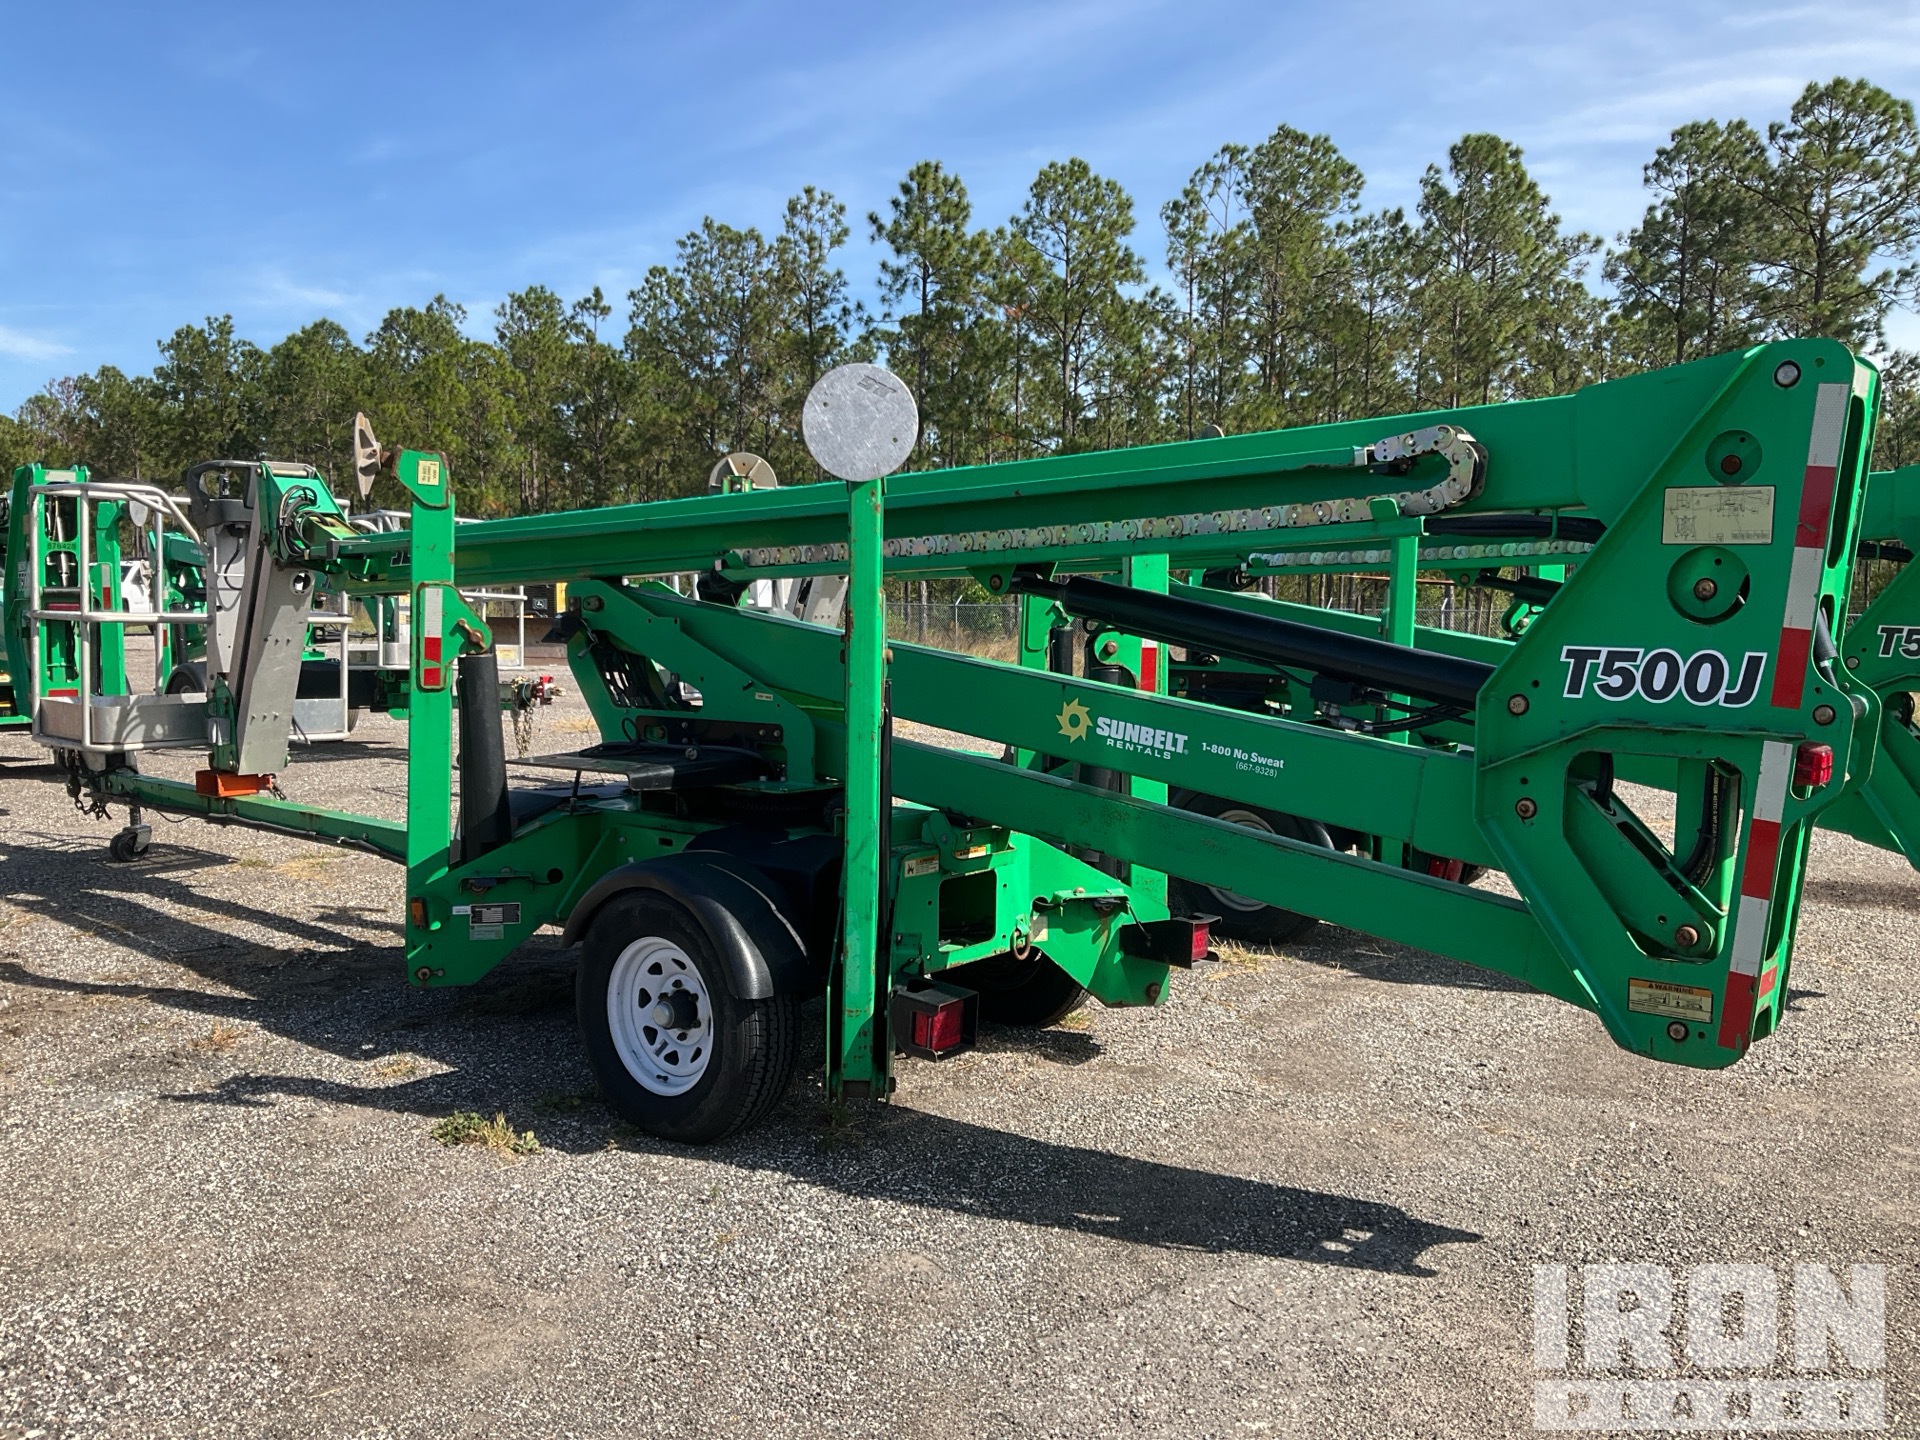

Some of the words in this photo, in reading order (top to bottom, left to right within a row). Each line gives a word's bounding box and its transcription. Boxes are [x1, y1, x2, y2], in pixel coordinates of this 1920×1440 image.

[1560, 646, 1768, 708] T500J
[1096, 716, 1188, 753] SUNBELT
[1106, 738, 1171, 760] RENTALS
[1202, 742, 1231, 756] 1-800
[1233, 748, 1249, 760] No
[1250, 752, 1284, 768] Sweat
[1235, 760, 1278, 778] (667-9328)
[1655, 984, 1694, 995] WARNING
